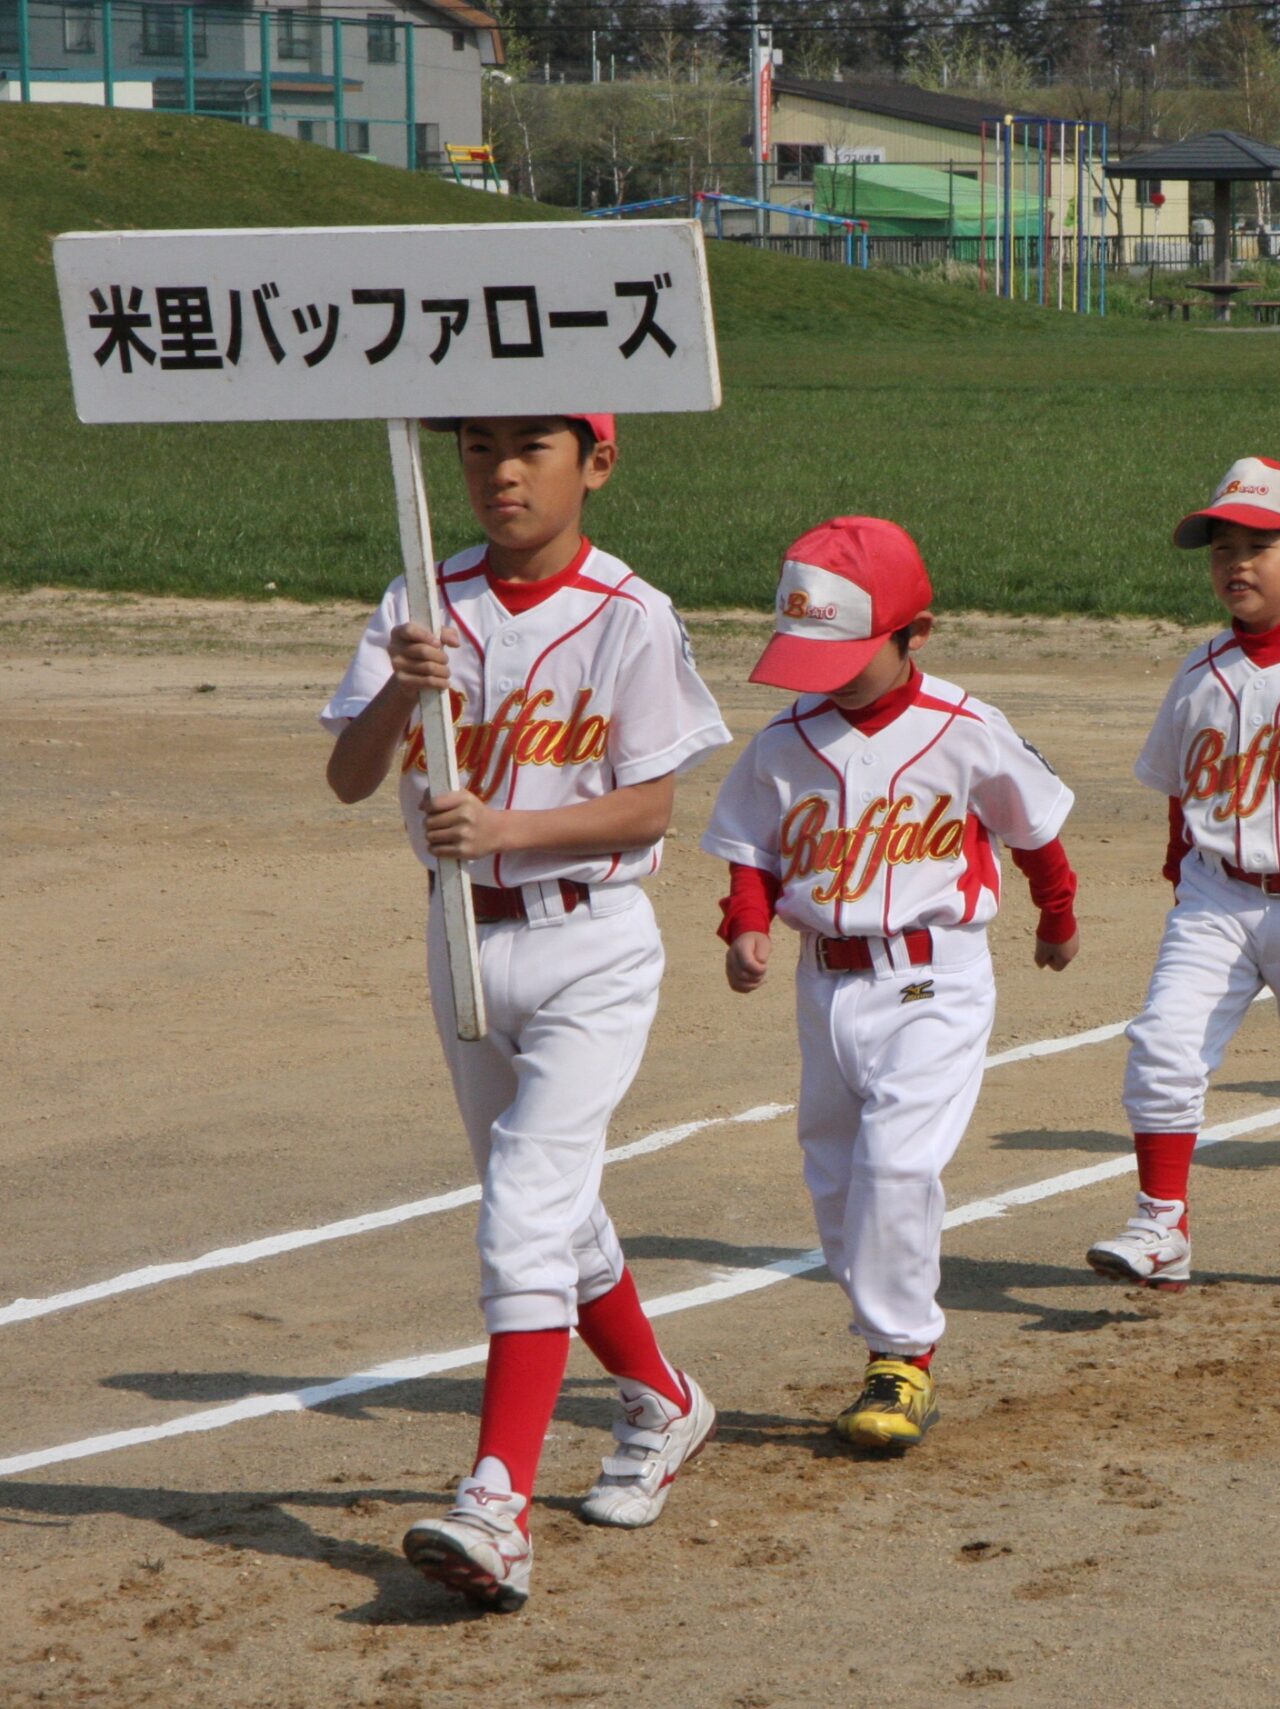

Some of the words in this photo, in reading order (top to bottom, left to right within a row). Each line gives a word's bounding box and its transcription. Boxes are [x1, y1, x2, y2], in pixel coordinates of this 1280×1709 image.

[88, 272, 677, 374] 米里バッファローズ
